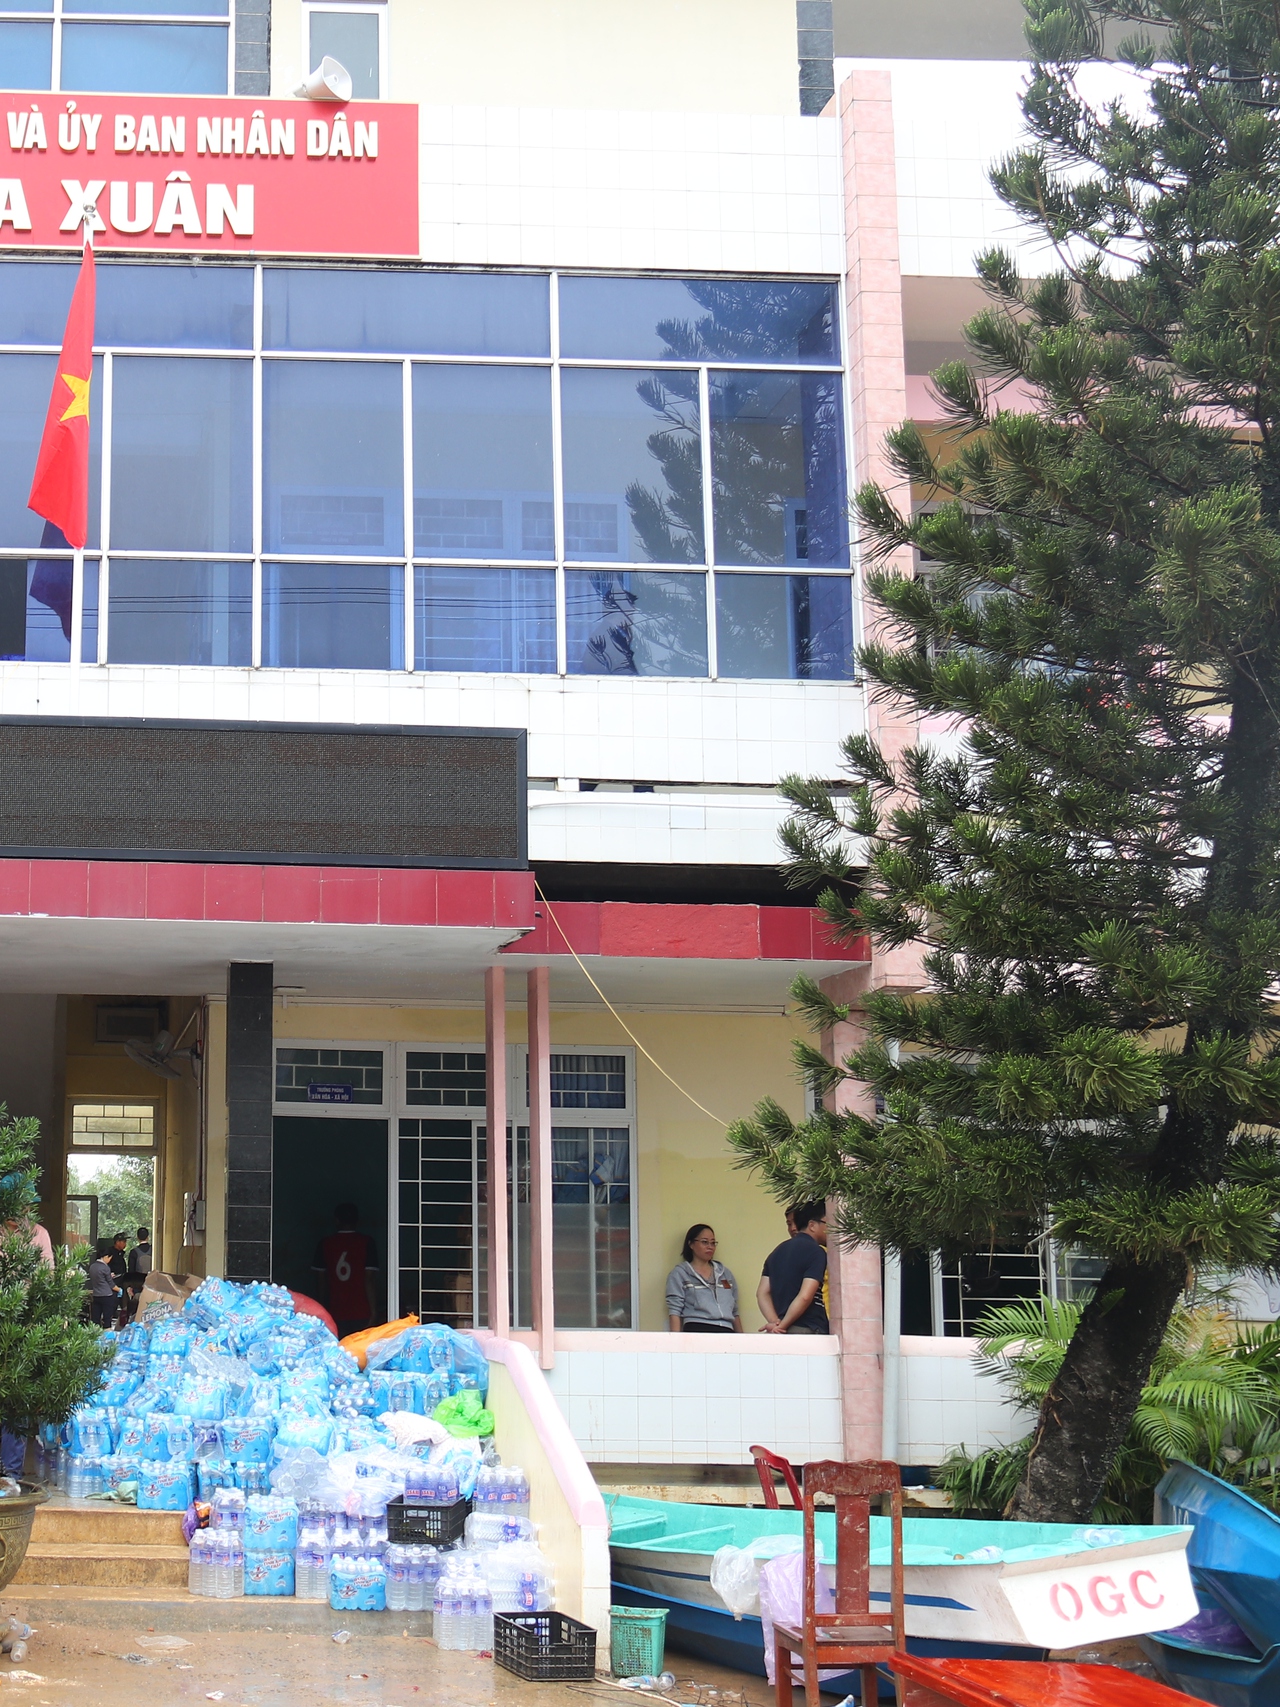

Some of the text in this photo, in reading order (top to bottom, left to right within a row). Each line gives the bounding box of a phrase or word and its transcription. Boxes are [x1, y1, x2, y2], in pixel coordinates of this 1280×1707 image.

[6, 104, 49, 152] VÀ
[57, 100, 103, 154] ỦY
[113, 114, 187, 155] BAN
[195, 109, 296, 159] NHÂN
[306, 111, 379, 160] DÂN
[58, 169, 255, 238] XUÂN
[335, 1251, 351, 1281] 6
[141, 1305, 173, 1323] LEMONA
[1049, 1570, 1165, 1621] OGC
